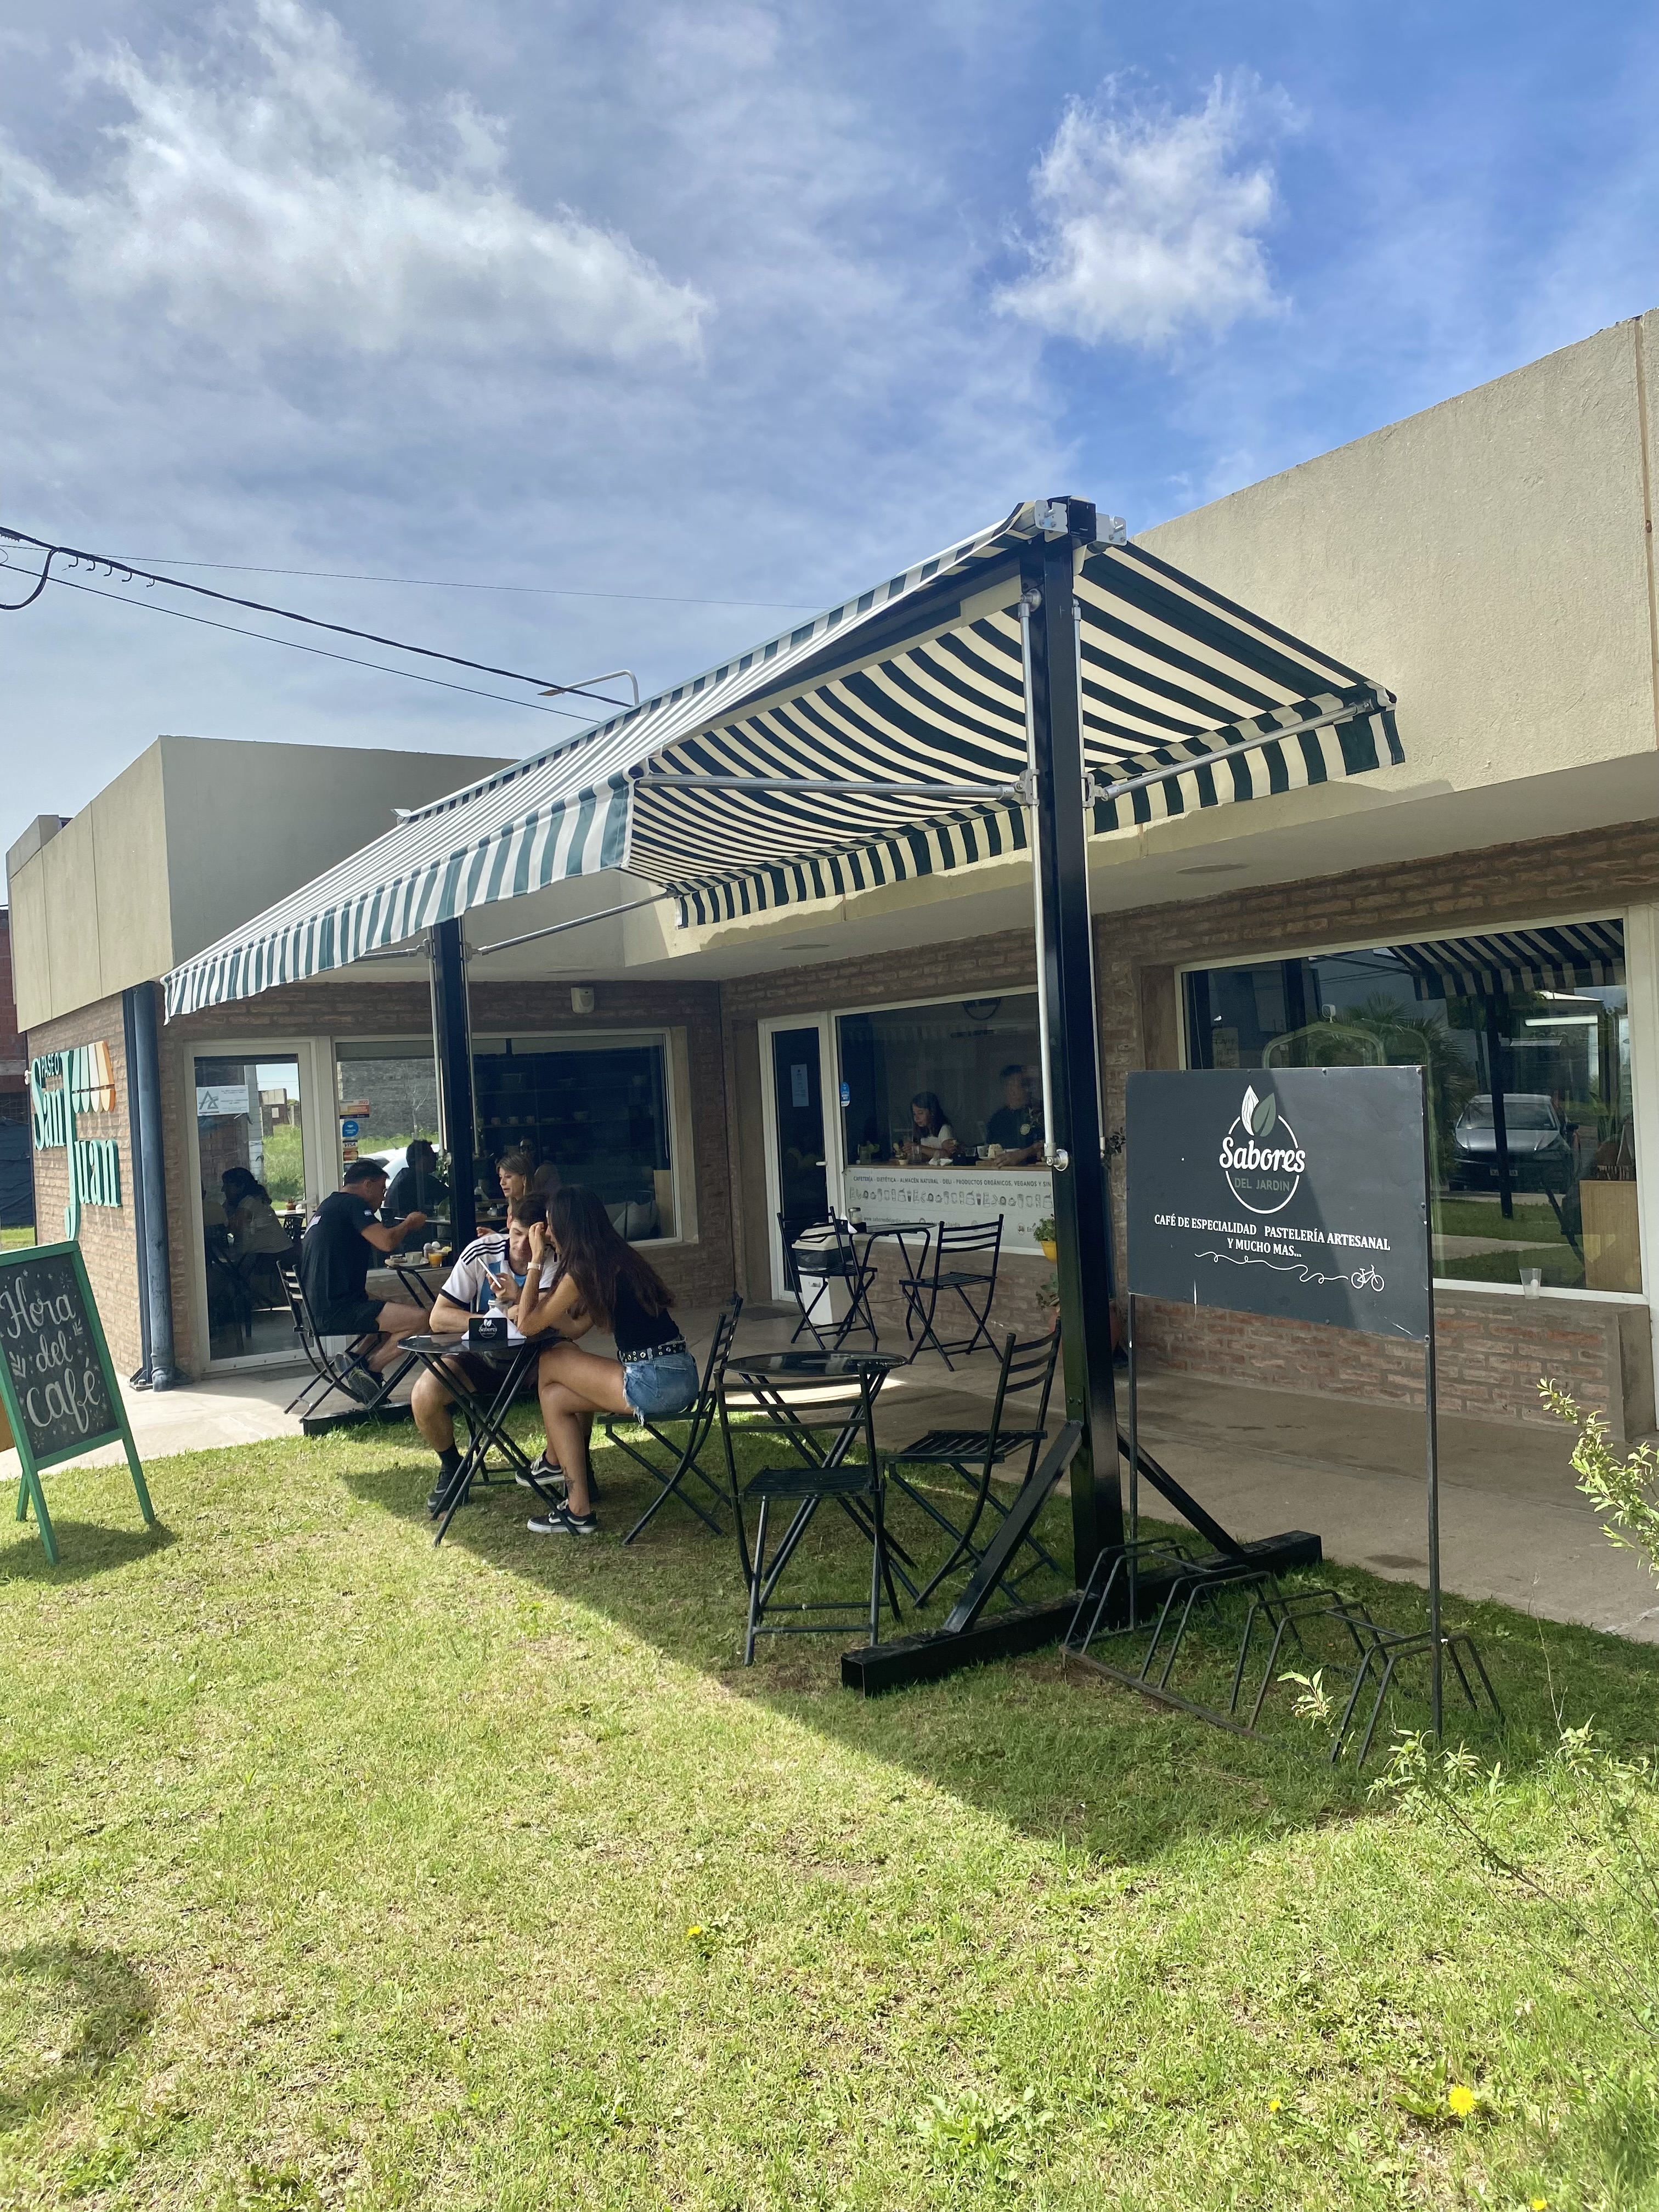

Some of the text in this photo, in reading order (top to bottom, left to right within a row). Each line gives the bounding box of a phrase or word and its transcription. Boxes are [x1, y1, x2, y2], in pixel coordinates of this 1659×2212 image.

[41, 1052, 59, 1078] PASEO
[31, 1057, 66, 1151] San
[60, 1050, 122, 1241] Juan
[1219, 1137, 1306, 1173] Sabores
[1234, 1177, 1290, 1192] DEL JARDIN
[1154, 1214, 1391, 1251] CAFÉ DE ESPECIALIDAD PASTELERÍA ARTESANAL
[1227, 1238, 1302, 1257] Y MUCHO MAS...
[36, 1330, 74, 1372] del
